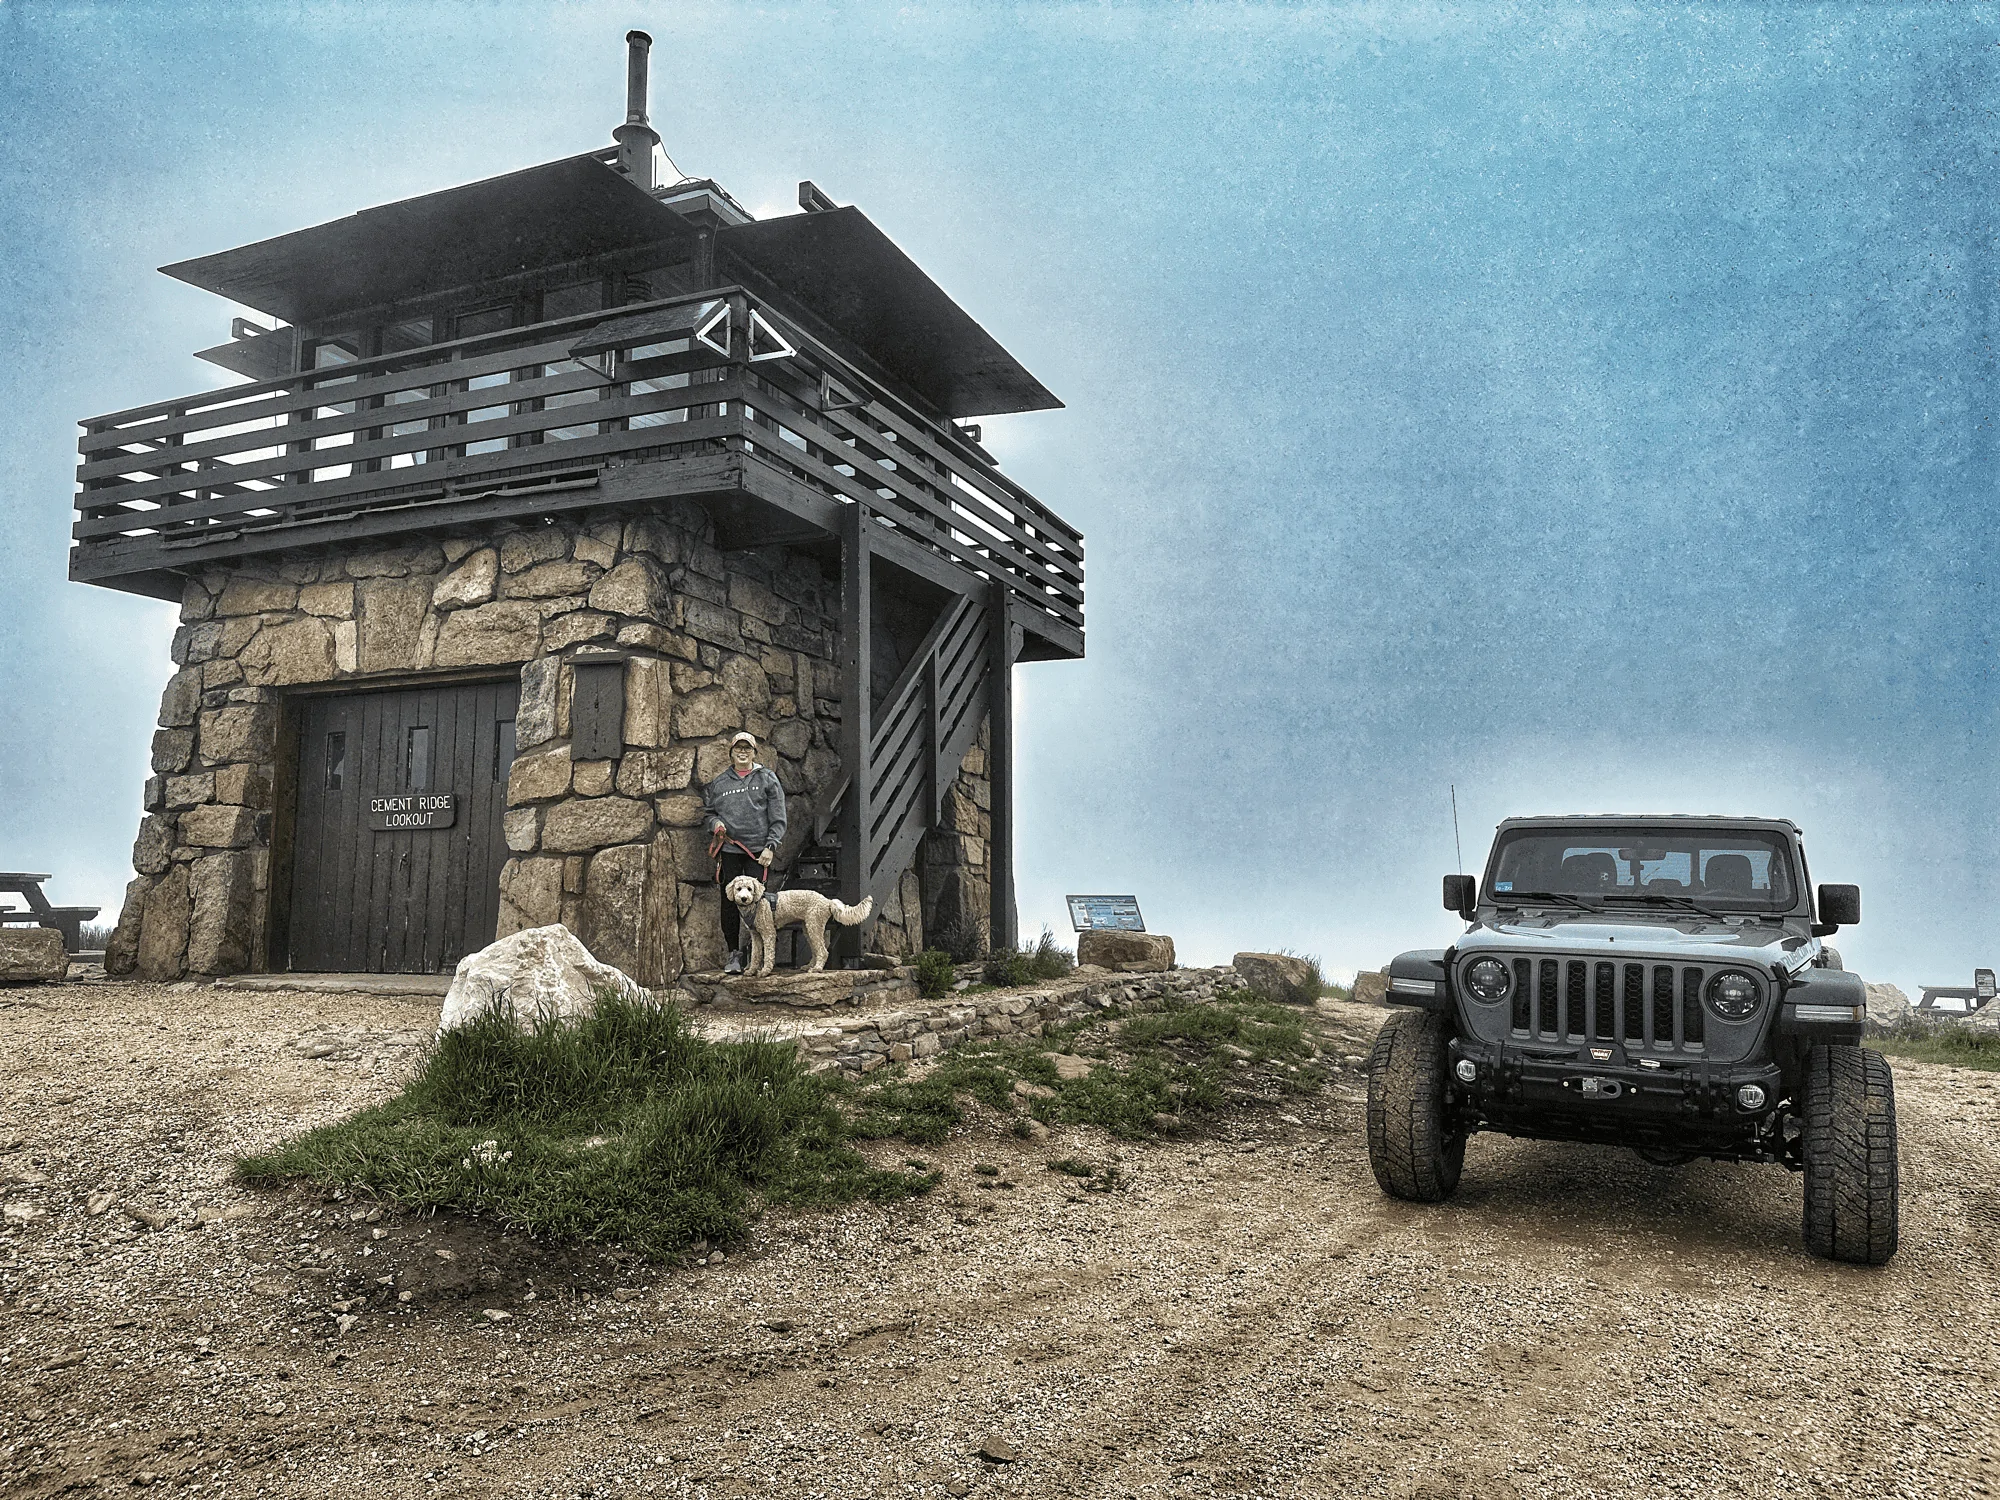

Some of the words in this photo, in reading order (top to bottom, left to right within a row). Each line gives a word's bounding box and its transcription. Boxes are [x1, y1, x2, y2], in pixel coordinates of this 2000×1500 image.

[371, 797, 413, 812] CEMENT
[419, 795, 451, 810] RIDGE
[385, 812, 434, 827] LOOKOUT
